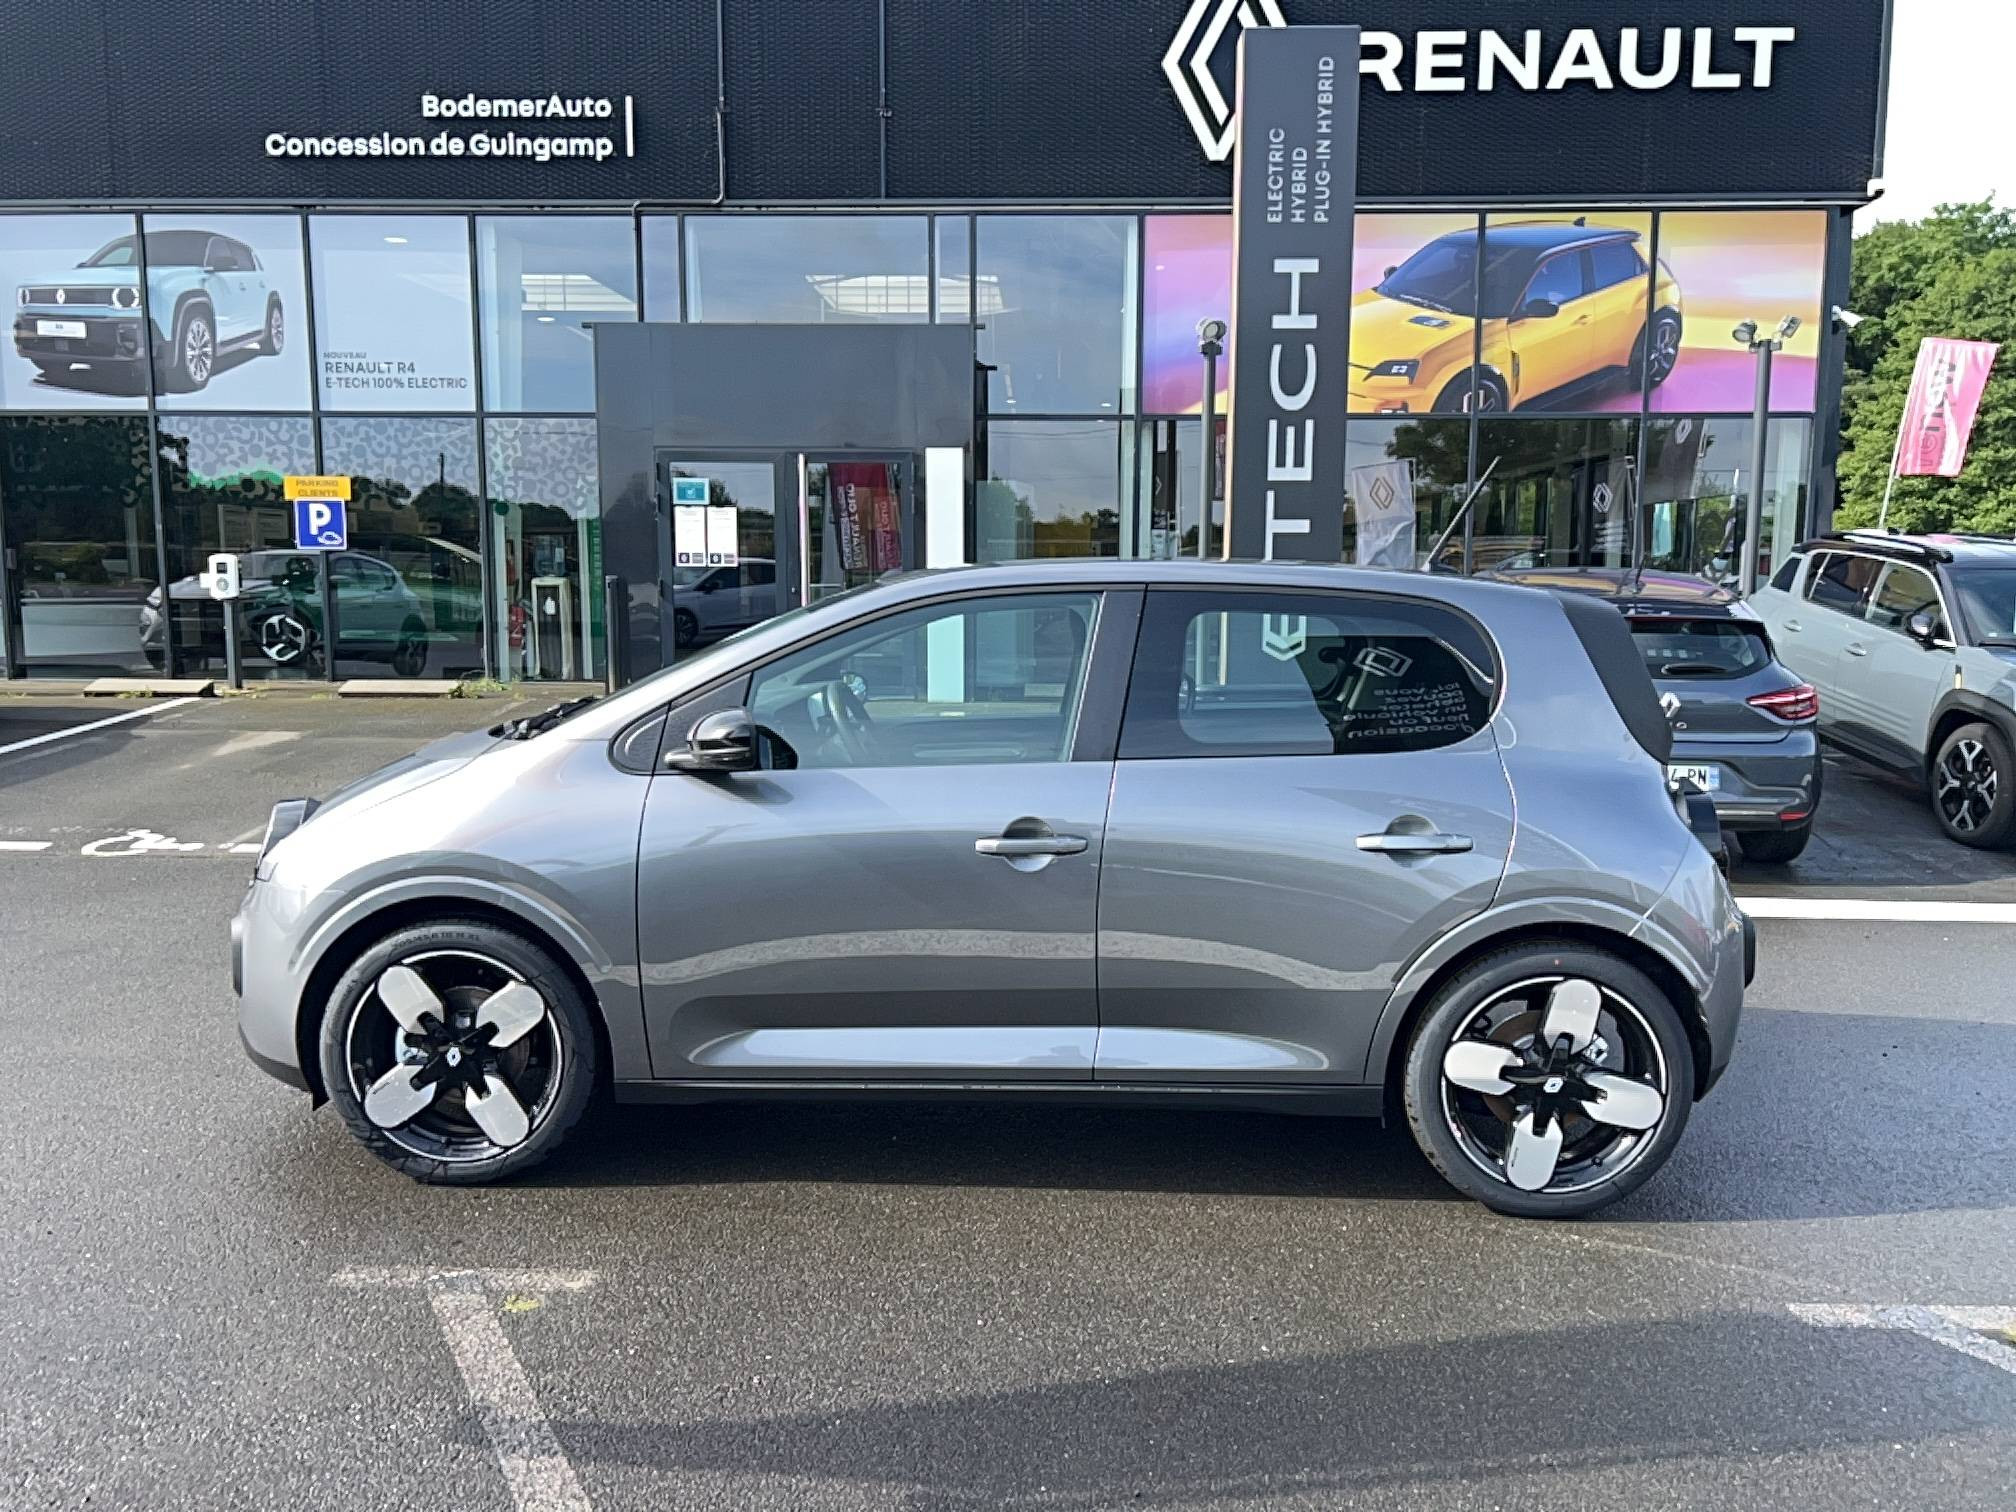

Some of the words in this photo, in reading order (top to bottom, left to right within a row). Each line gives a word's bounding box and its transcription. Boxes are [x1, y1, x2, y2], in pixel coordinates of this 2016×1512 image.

[1359, 26, 1796, 92] RENAULT
[421, 93, 613, 118] BodemerAuto
[1316, 55, 1336, 134] HYBRID
[265, 132, 425, 157] Concession
[430, 131, 465, 157] de
[469, 131, 614, 162] Guingamp
[1266, 127, 1286, 223] ELECTRIC
[1290, 146, 1308, 223] HYBRID
[1313, 138, 1332, 224] PLUG-IN
[323, 351, 367, 359] NOUVEAU
[324, 361, 394, 374] RENAULT
[397, 361, 416, 374] R4
[325, 377, 370, 389] E-TECH
[372, 377, 405, 389] 100%
[407, 377, 468, 389] ELECTRIC
[308, 502, 332, 536] P
